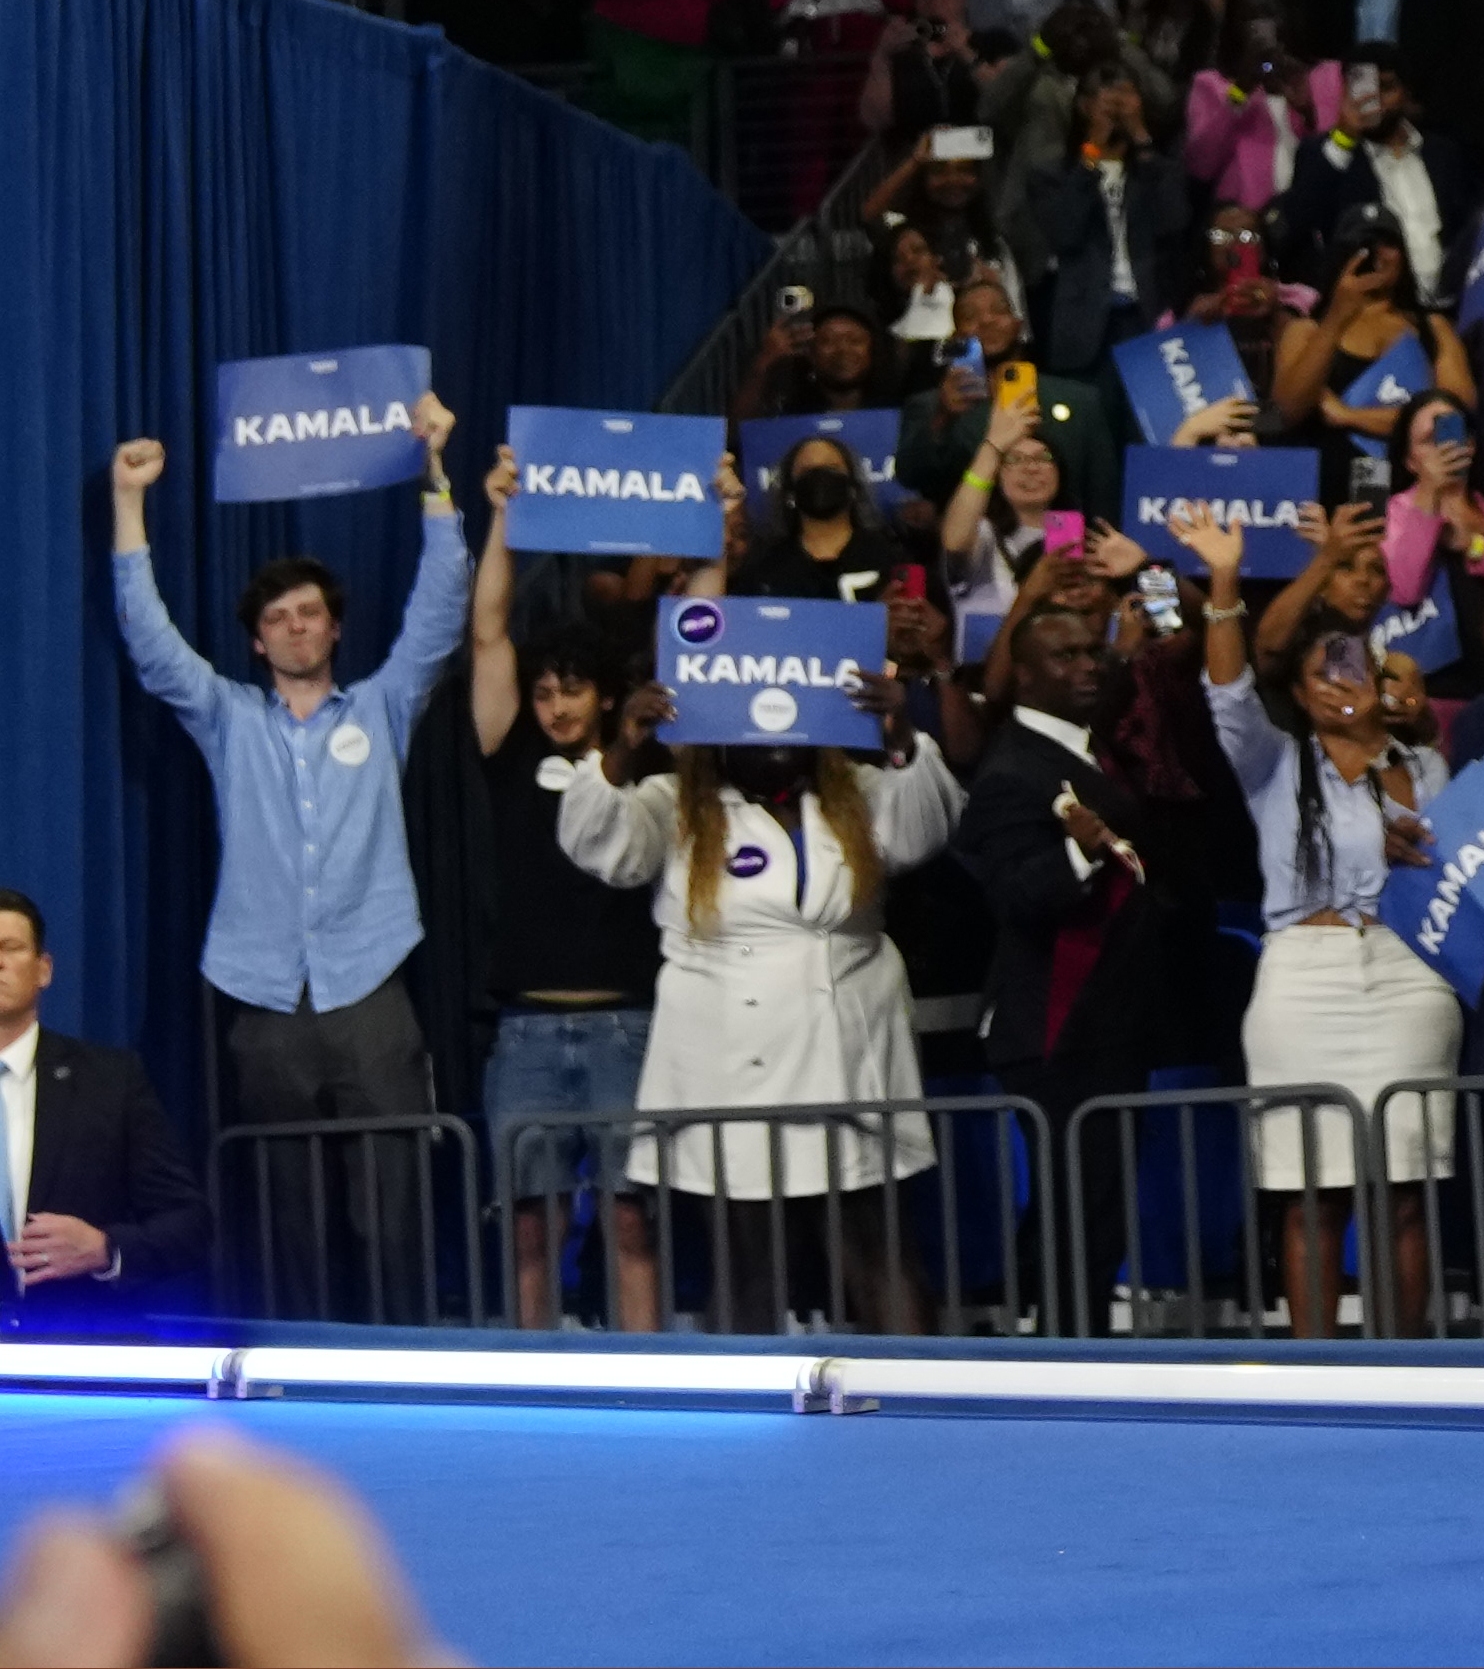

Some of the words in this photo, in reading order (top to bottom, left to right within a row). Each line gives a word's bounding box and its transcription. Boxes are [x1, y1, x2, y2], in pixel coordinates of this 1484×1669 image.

[235, 400, 412, 447] KAMALA
[526, 465, 706, 504] KAMALA
[677, 653, 864, 690] KAMALA
